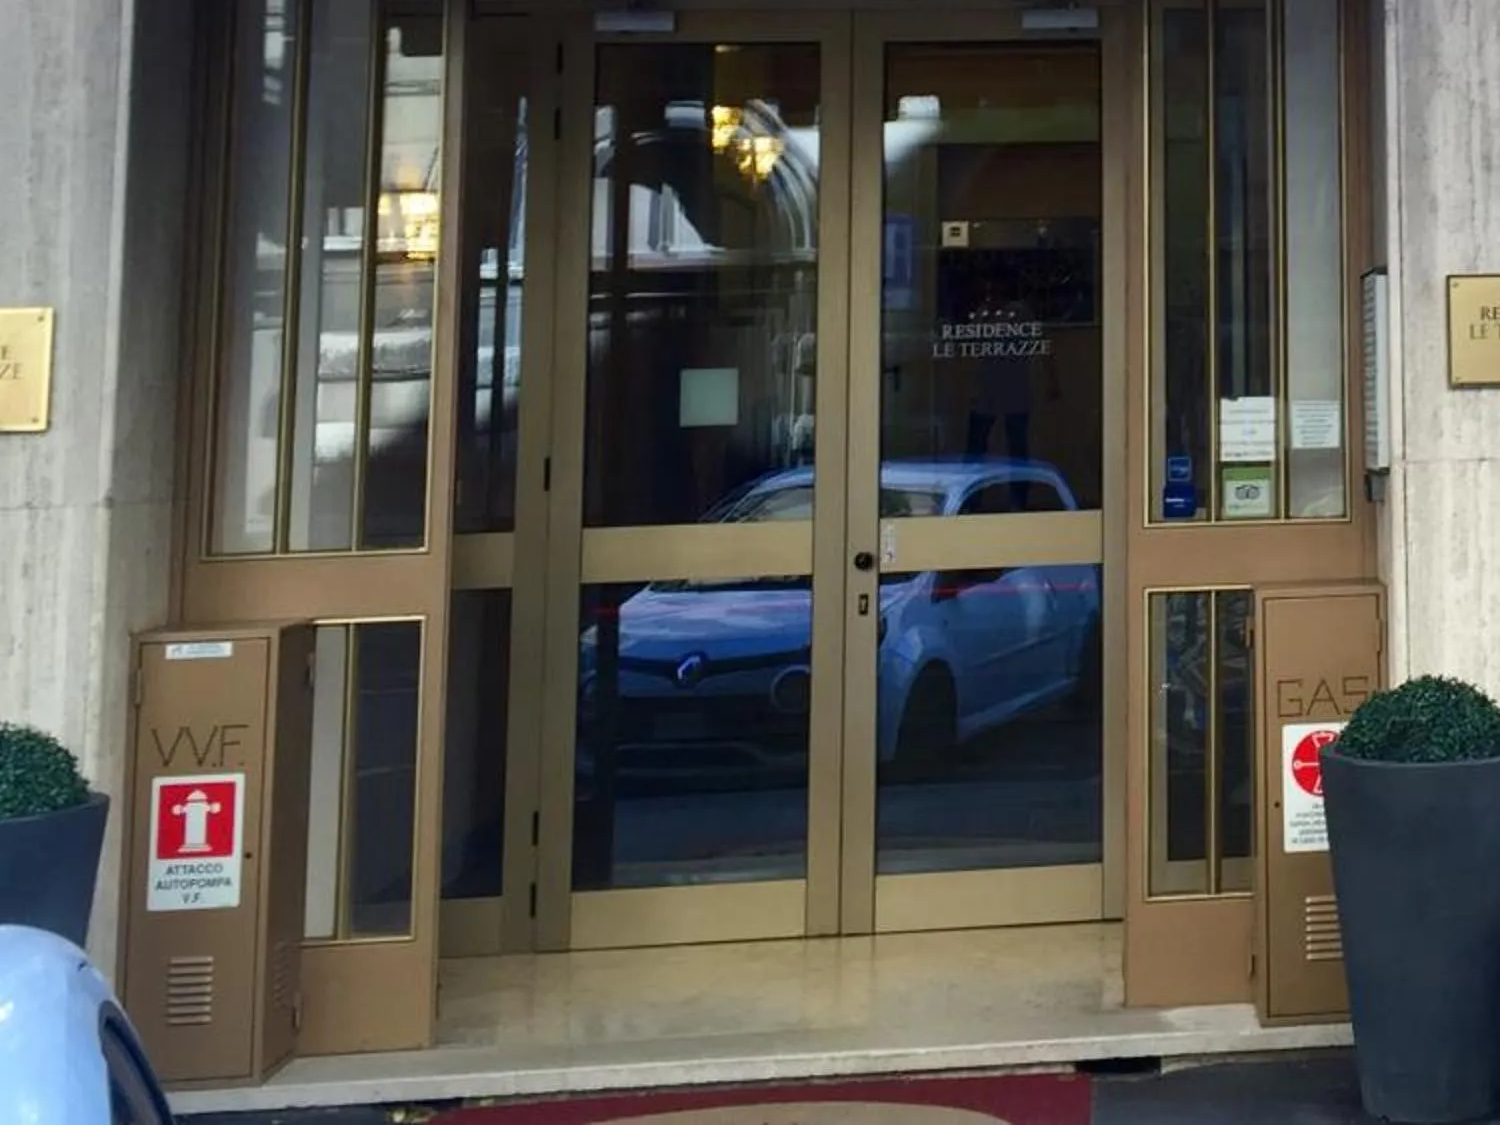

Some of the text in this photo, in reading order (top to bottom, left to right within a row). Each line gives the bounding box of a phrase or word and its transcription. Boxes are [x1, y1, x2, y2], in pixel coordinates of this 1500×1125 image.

[942, 321, 1043, 339] RESIDENCE
[1469, 323, 1488, 340] LE
[933, 340, 1052, 358] LE TERRAZZE
[1277, 676, 1369, 718] GAS
[166, 862, 223, 876] ATTACCO
[154, 877, 232, 891] AUTOPOMPA
